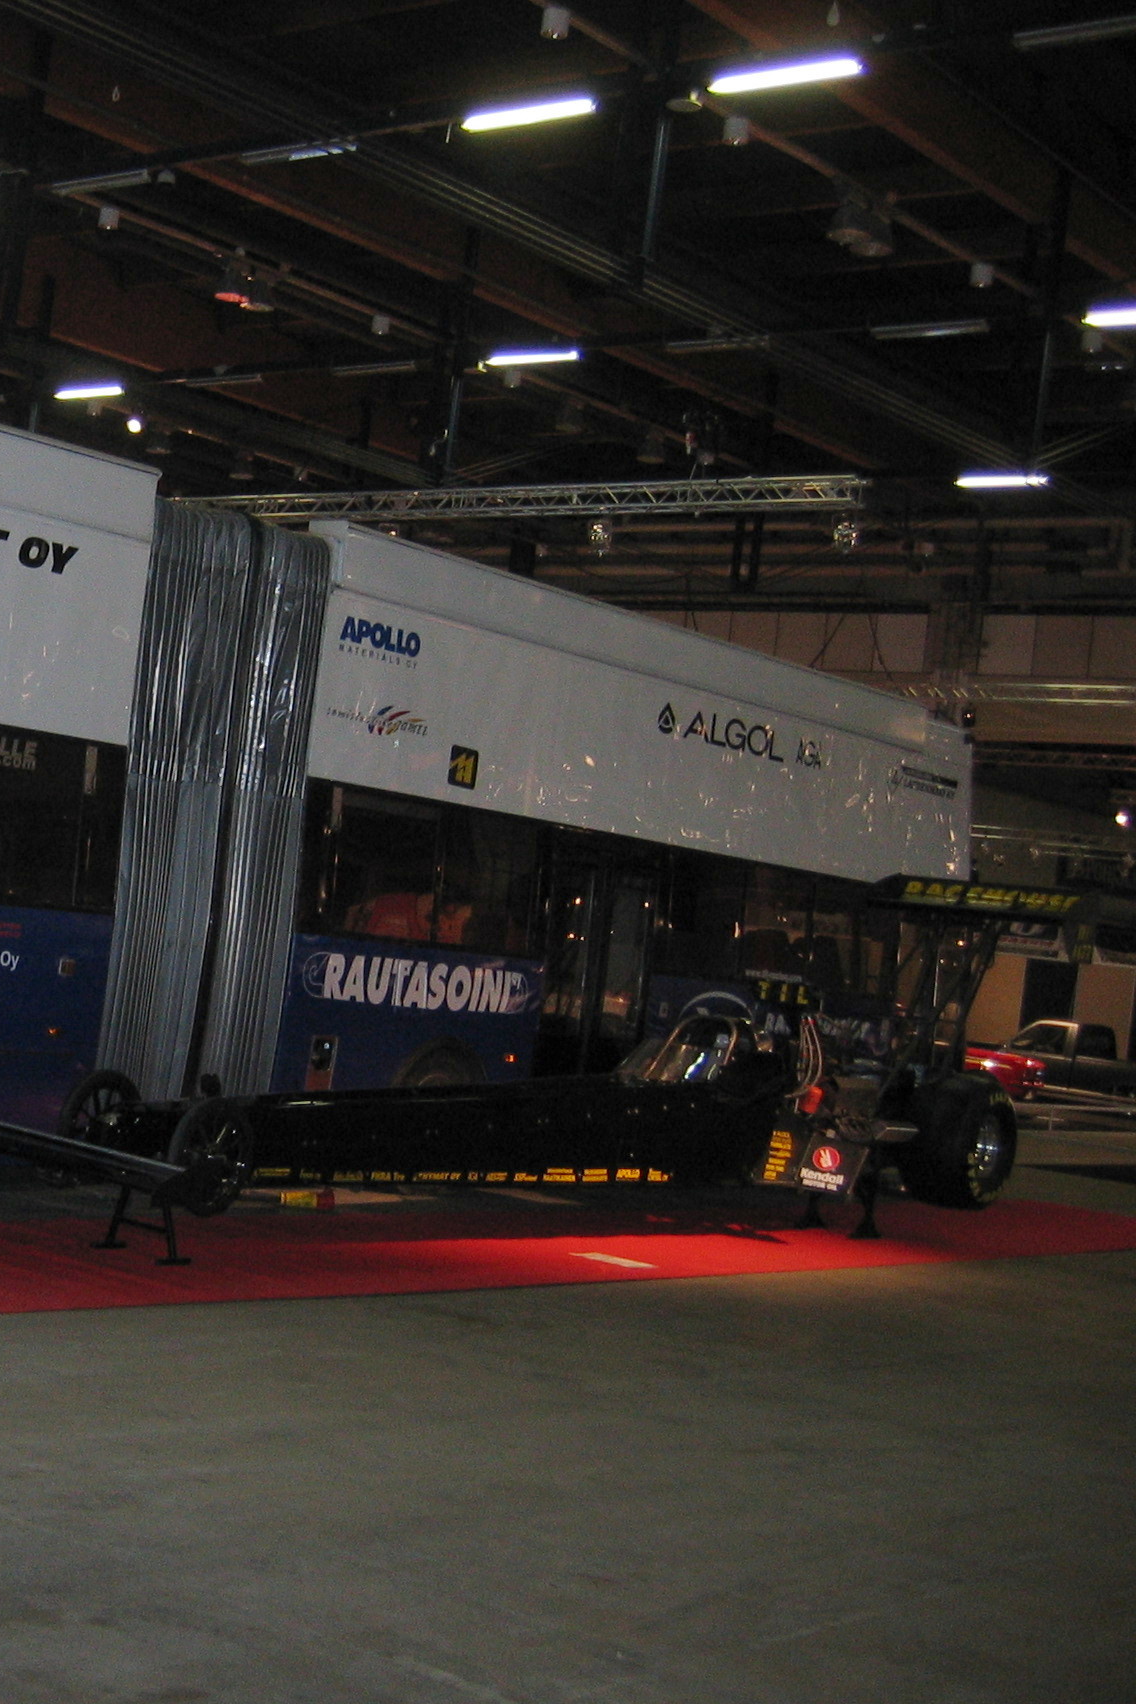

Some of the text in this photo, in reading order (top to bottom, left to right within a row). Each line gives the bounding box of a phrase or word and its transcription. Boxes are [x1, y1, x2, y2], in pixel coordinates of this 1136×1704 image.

[17, 536, 79, 575] OY
[340, 616, 421, 657] APOLLO
[683, 711, 784, 762] ALGOL
[0, 951, 20, 972] Oy
[800, 1167, 844, 1186] Kendall
